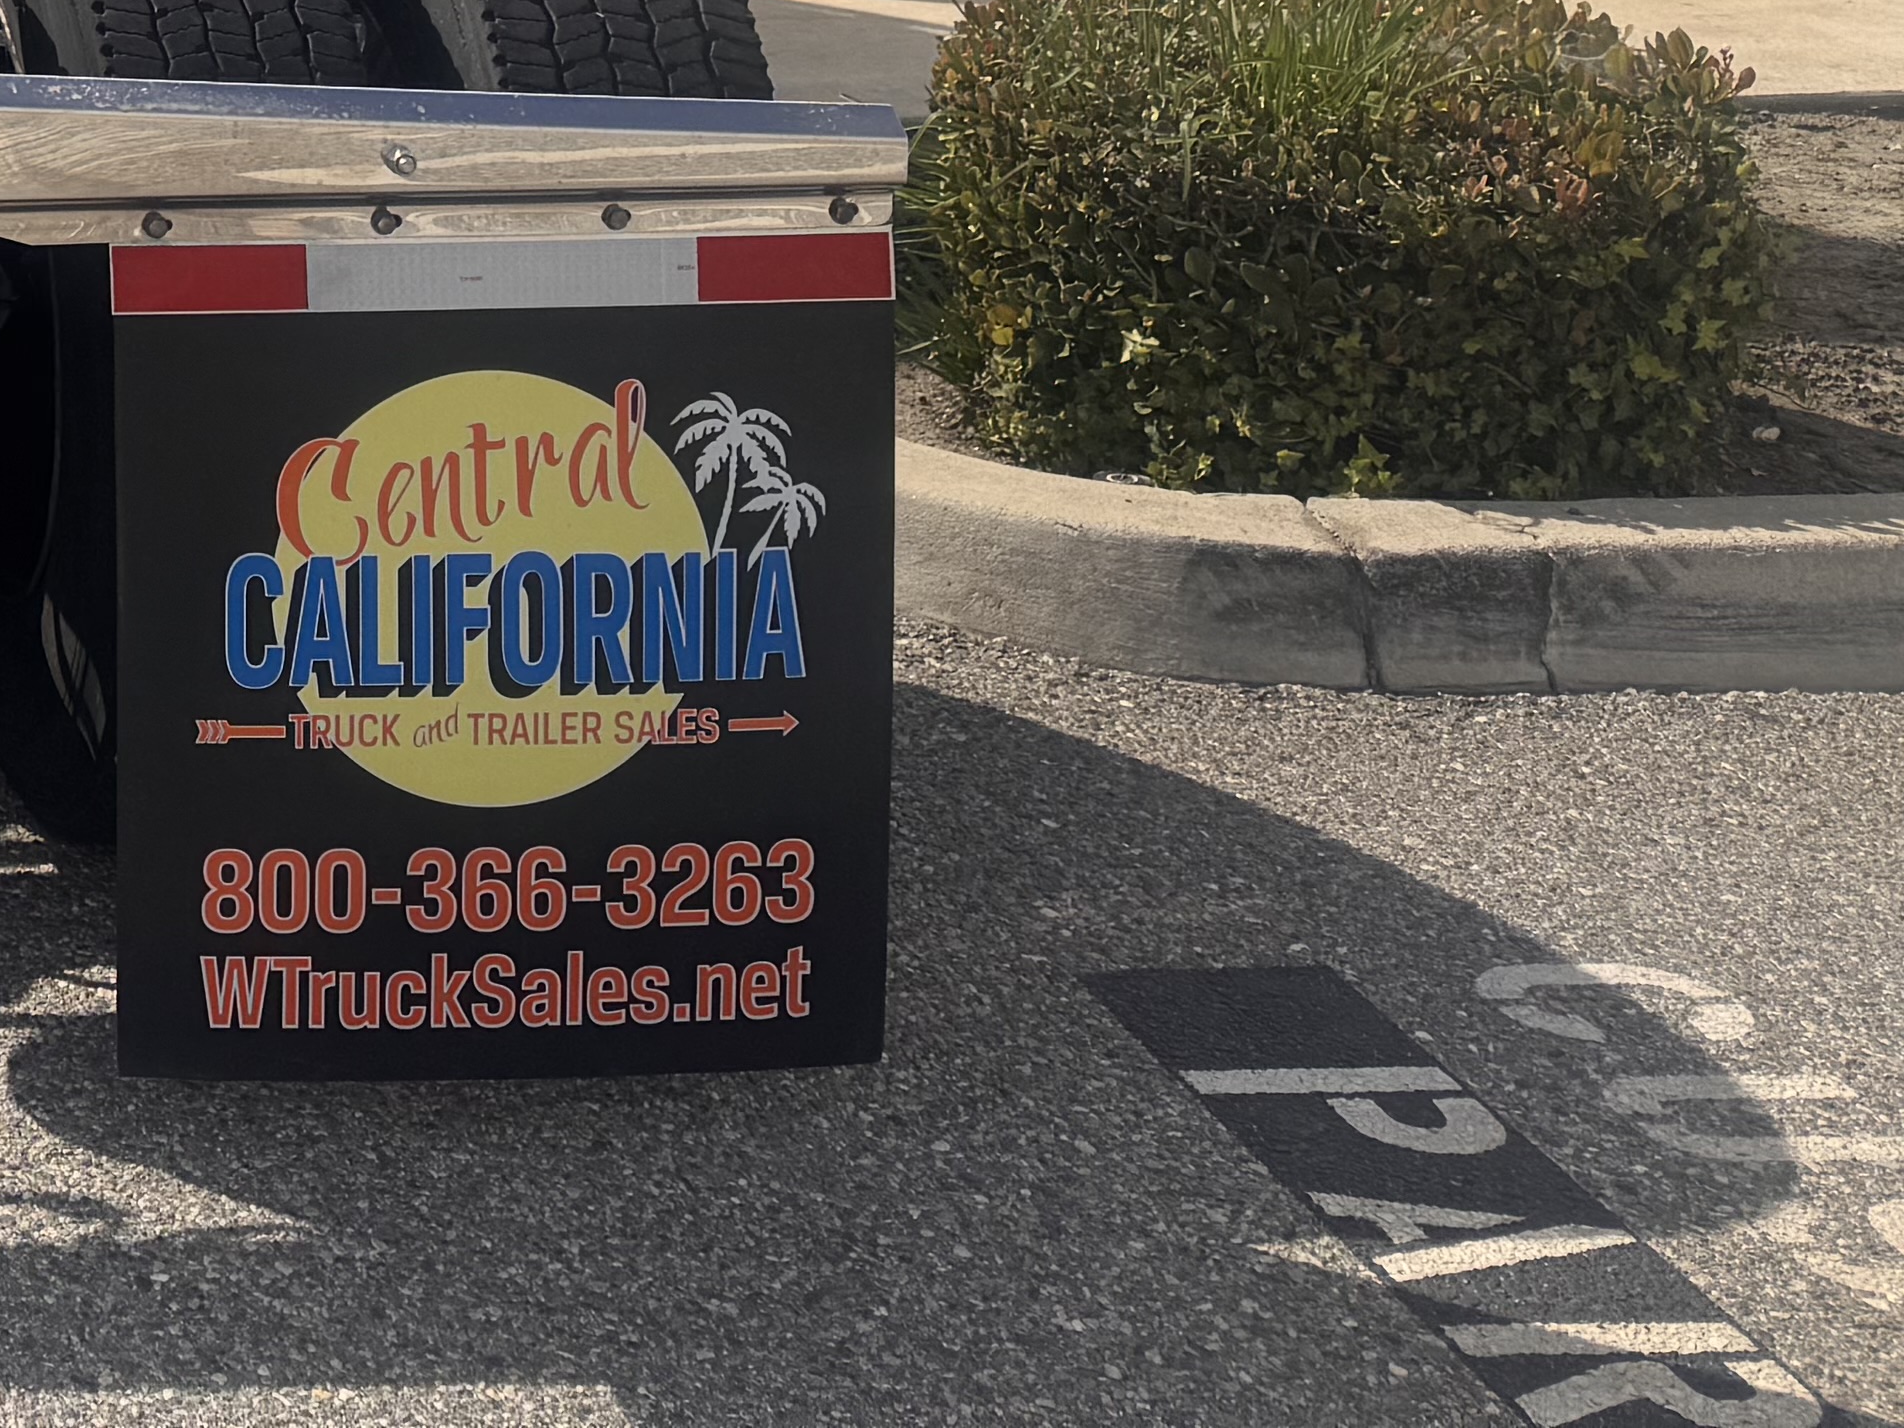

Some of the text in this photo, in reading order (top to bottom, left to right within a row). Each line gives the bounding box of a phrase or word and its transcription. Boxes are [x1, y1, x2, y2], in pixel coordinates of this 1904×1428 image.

[276, 378, 651, 566] Central
[225, 547, 806, 690] CALIFORNIA
[288, 702, 720, 750] TRUCK and TRAILER SALES
[200, 838, 816, 935] 800-366-3263
[199, 945, 812, 1030] WTruckSales.net
